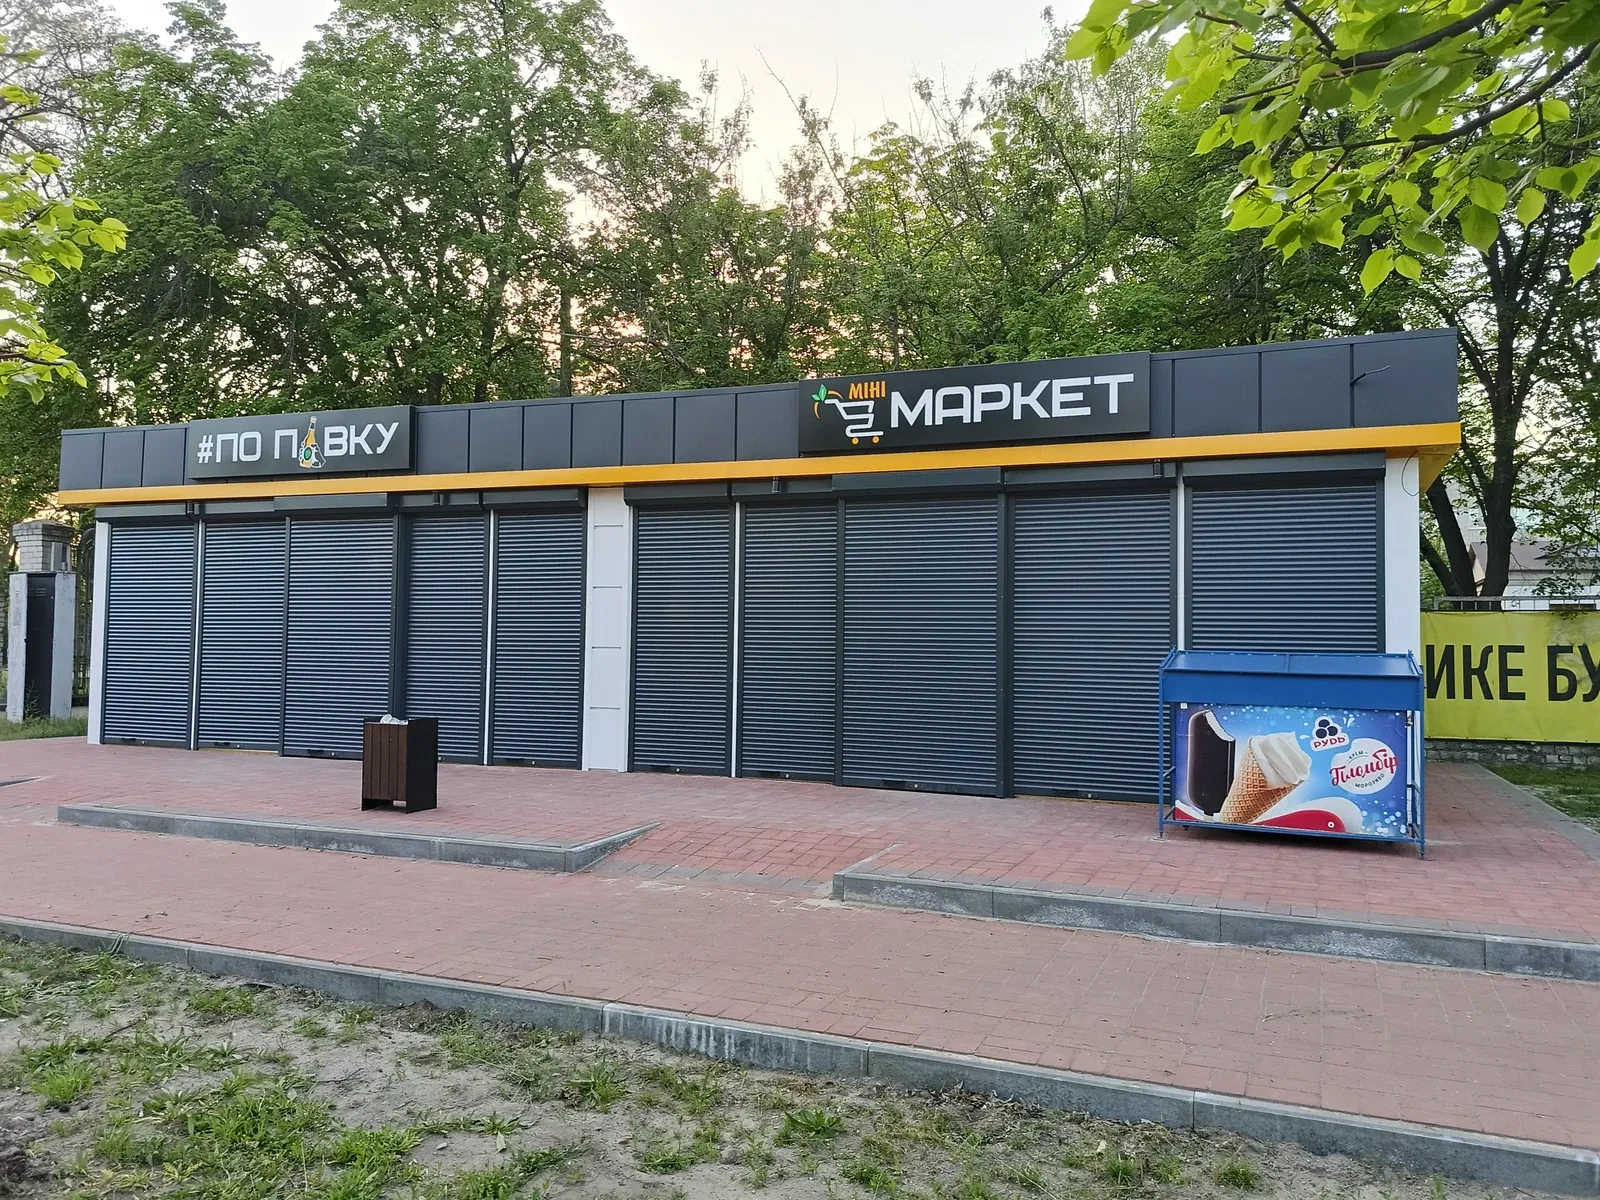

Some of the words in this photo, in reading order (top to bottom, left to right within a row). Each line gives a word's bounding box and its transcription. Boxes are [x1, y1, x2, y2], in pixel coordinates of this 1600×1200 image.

[849, 381, 886, 400] МІНІ
[890, 373, 1135, 428] МАРКЕТ
[197, 431, 262, 464] #ПО
[274, 419, 399, 464] ПВКУ
[1425, 644, 1526, 701] ИКЕ
[1547, 643, 1600, 702] БУ
[1313, 736, 1346, 749] РУДЬ
[1329, 749, 1399, 786] Пломбір
[1354, 773, 1385, 788] МОРОЗИВО
